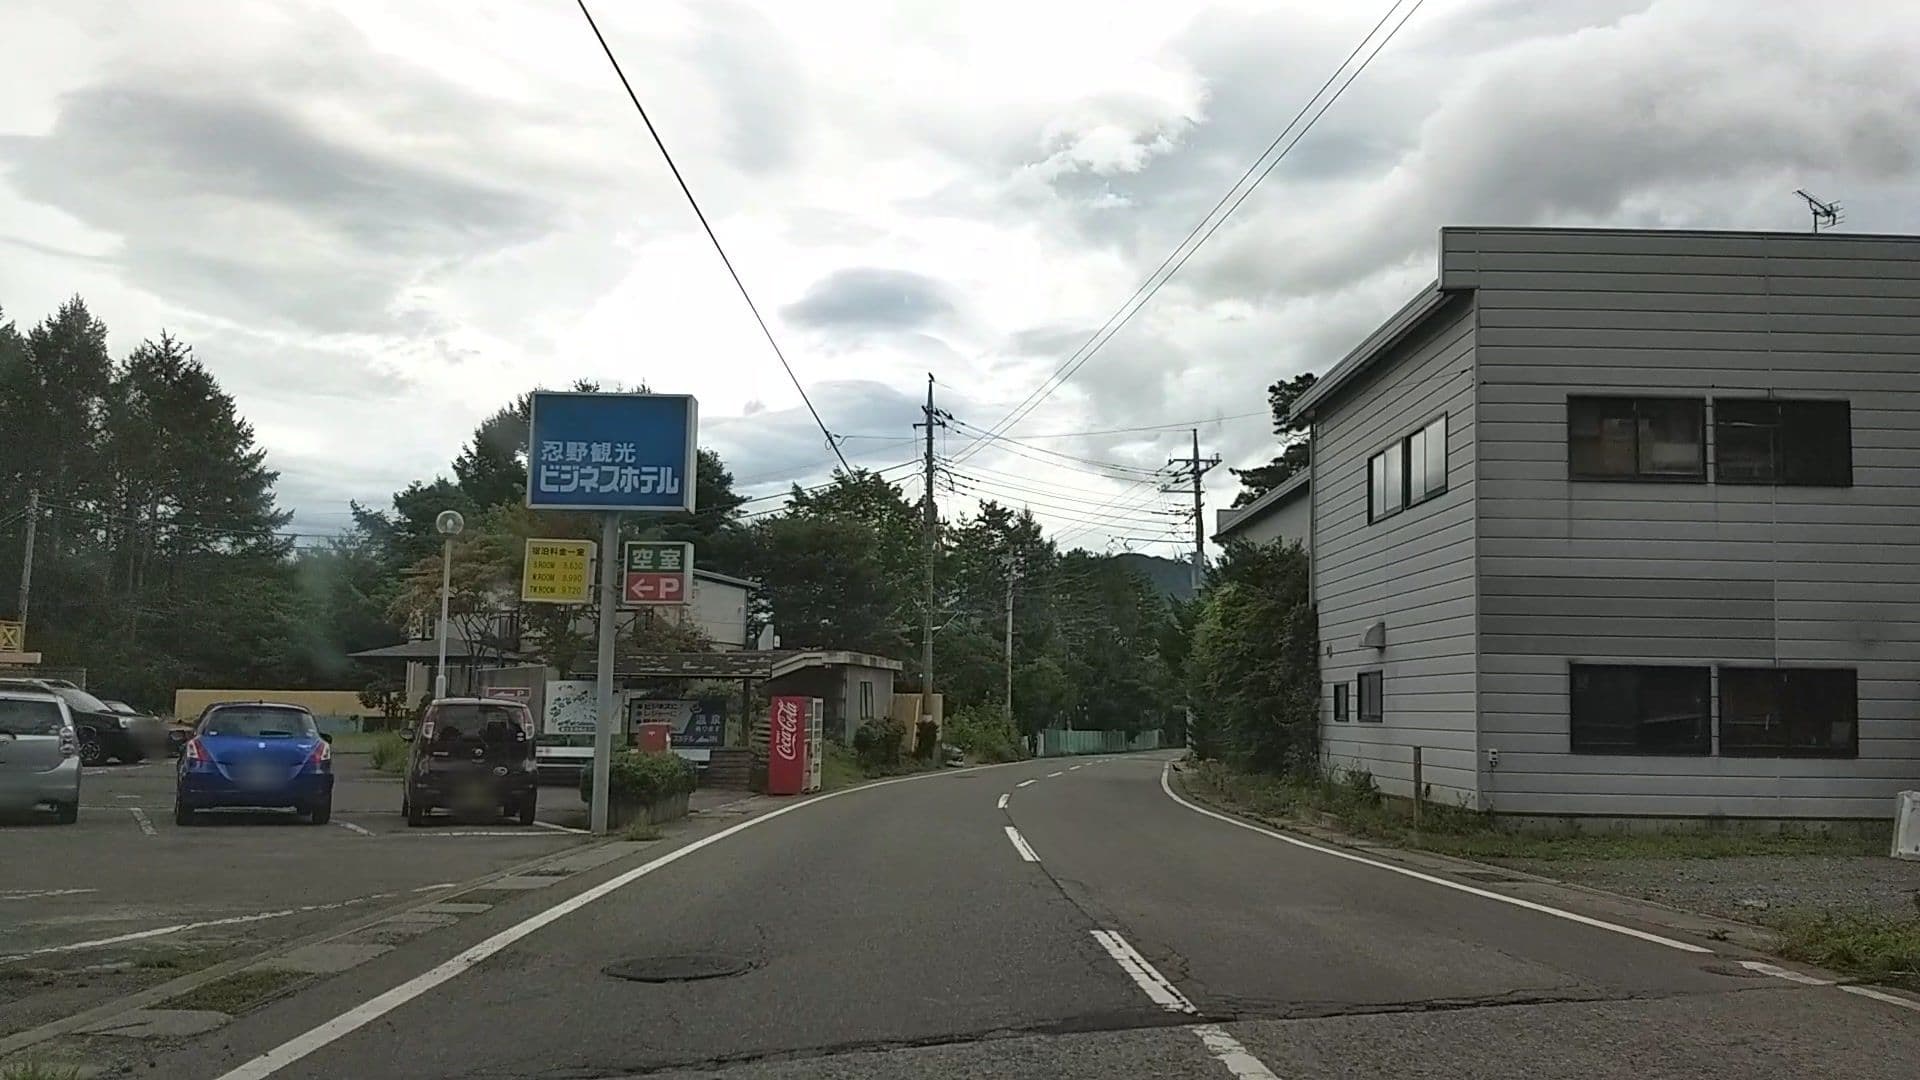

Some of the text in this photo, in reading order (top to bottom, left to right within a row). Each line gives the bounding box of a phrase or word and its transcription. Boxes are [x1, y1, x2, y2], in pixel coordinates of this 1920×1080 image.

[541, 441, 636, 463] 忍野観光
[540, 465, 680, 494] ビジネスホテル
[631, 549, 681, 570] 空室
[660, 578, 680, 599] P
